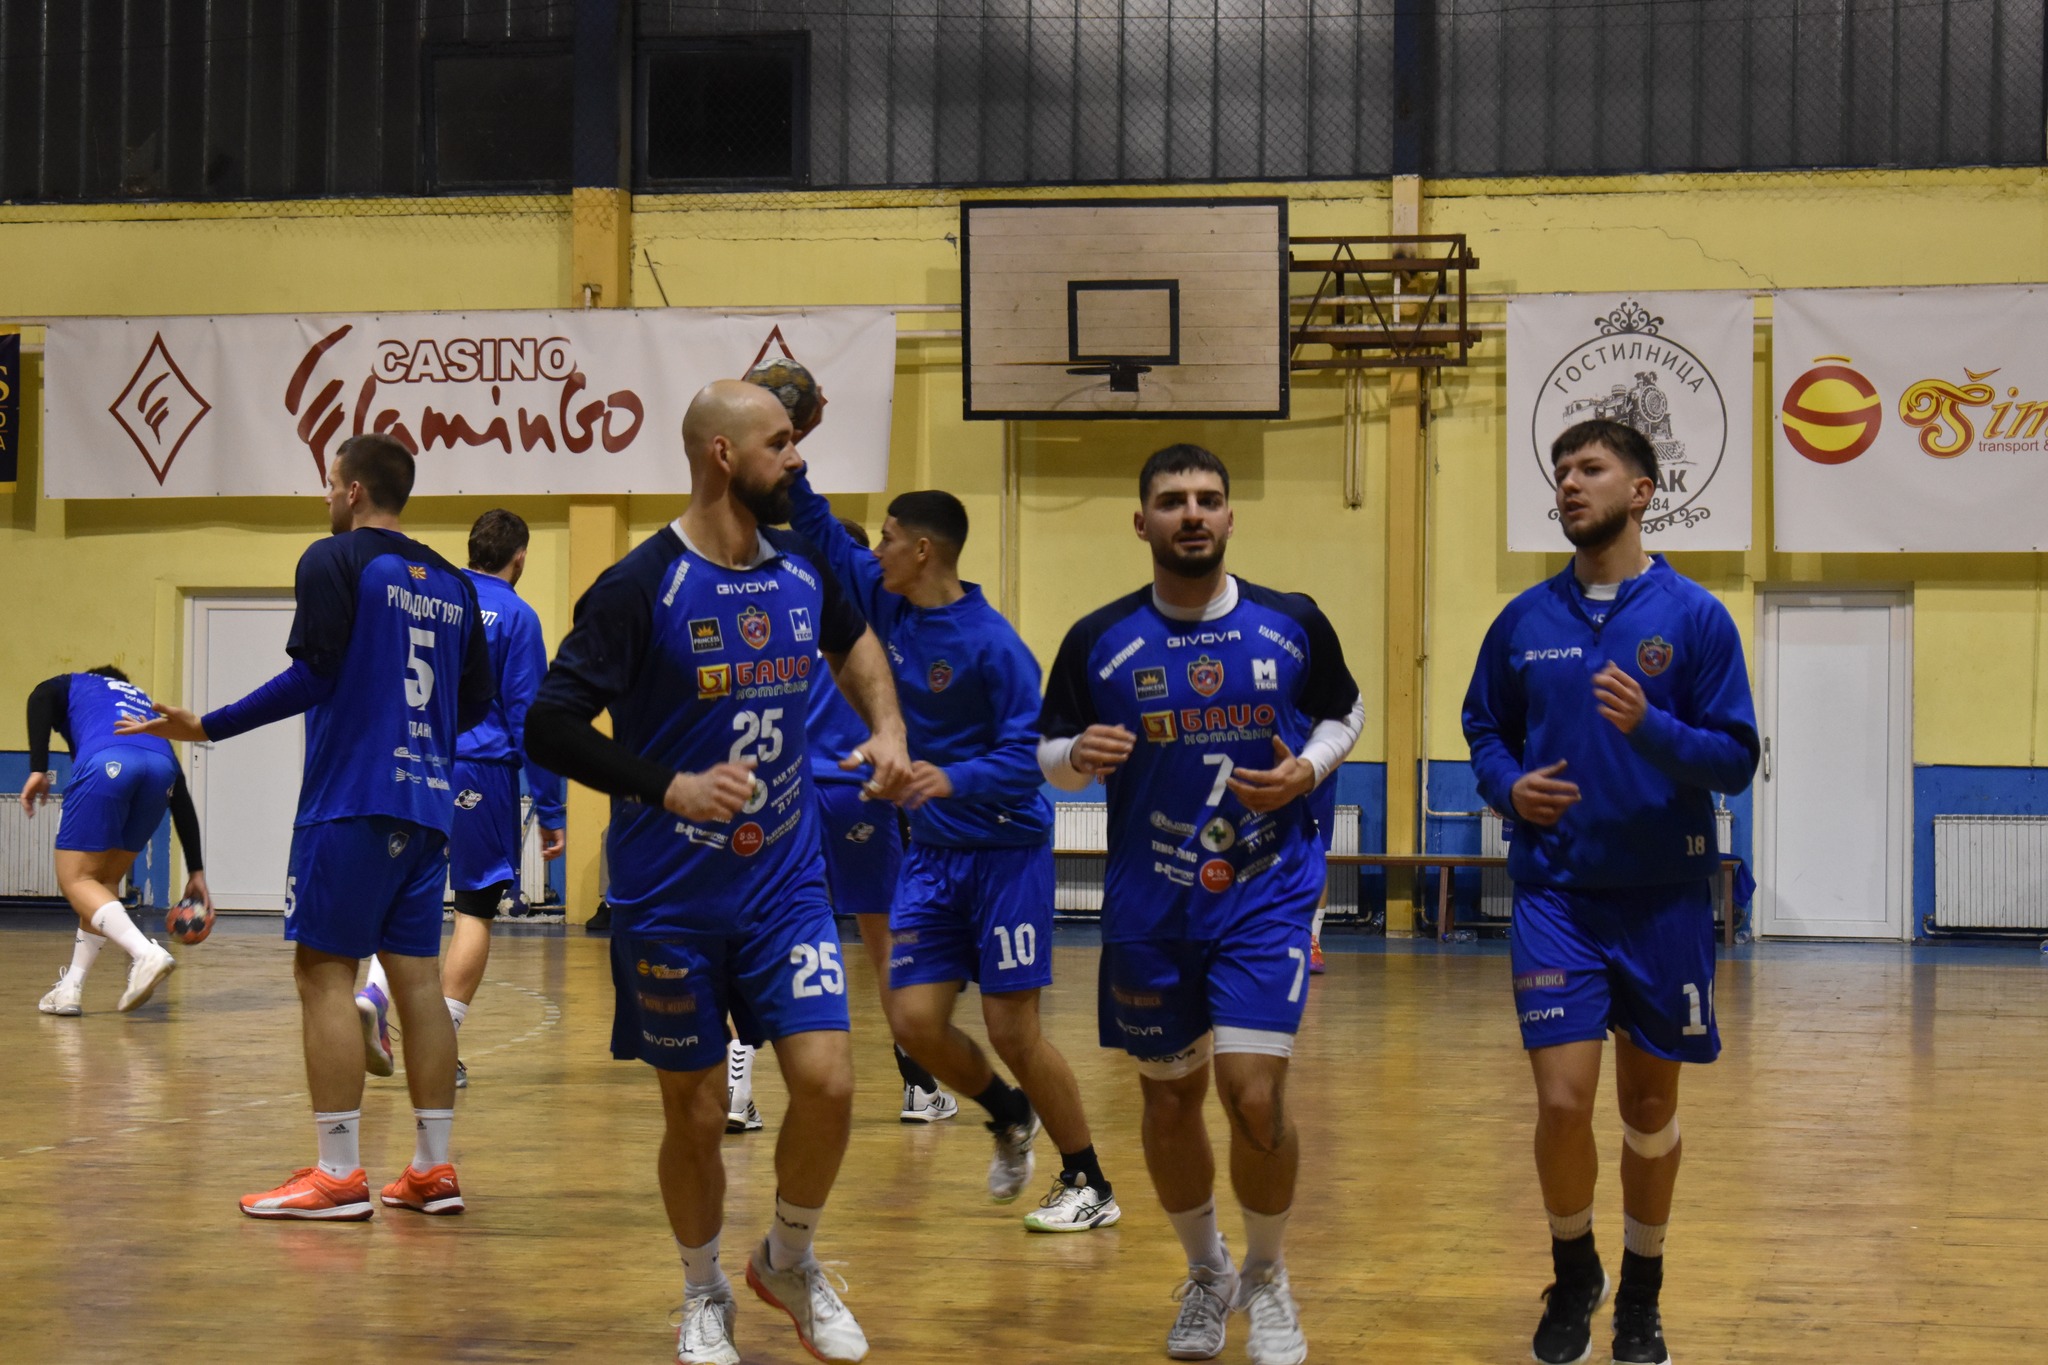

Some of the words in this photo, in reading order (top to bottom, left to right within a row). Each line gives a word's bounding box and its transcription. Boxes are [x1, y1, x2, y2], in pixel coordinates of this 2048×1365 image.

[371, 336, 577, 384] CASINO
[1554, 342, 1705, 394] ГОСТИЛНИЦА
[1979, 441, 2039, 454] transport
[716, 580, 779, 595] GIVOVA
[1167, 630, 1241, 648] GIVOVA
[1525, 647, 1583, 661] GIVOVA
[404, 626, 435, 711] 5
[1255, 681, 1277, 690] TECH
[729, 708, 783, 764] 25
[1203, 753, 1234, 806] 7
[1686, 835, 1705, 856] 18
[994, 922, 1036, 970] 10
[790, 942, 845, 999] 25
[1287, 947, 1305, 1002] 7
[1535, 973, 1564, 987] MEDICA
[1682, 978, 1713, 1036] 1
[643, 1030, 699, 1047] GIVOVA
